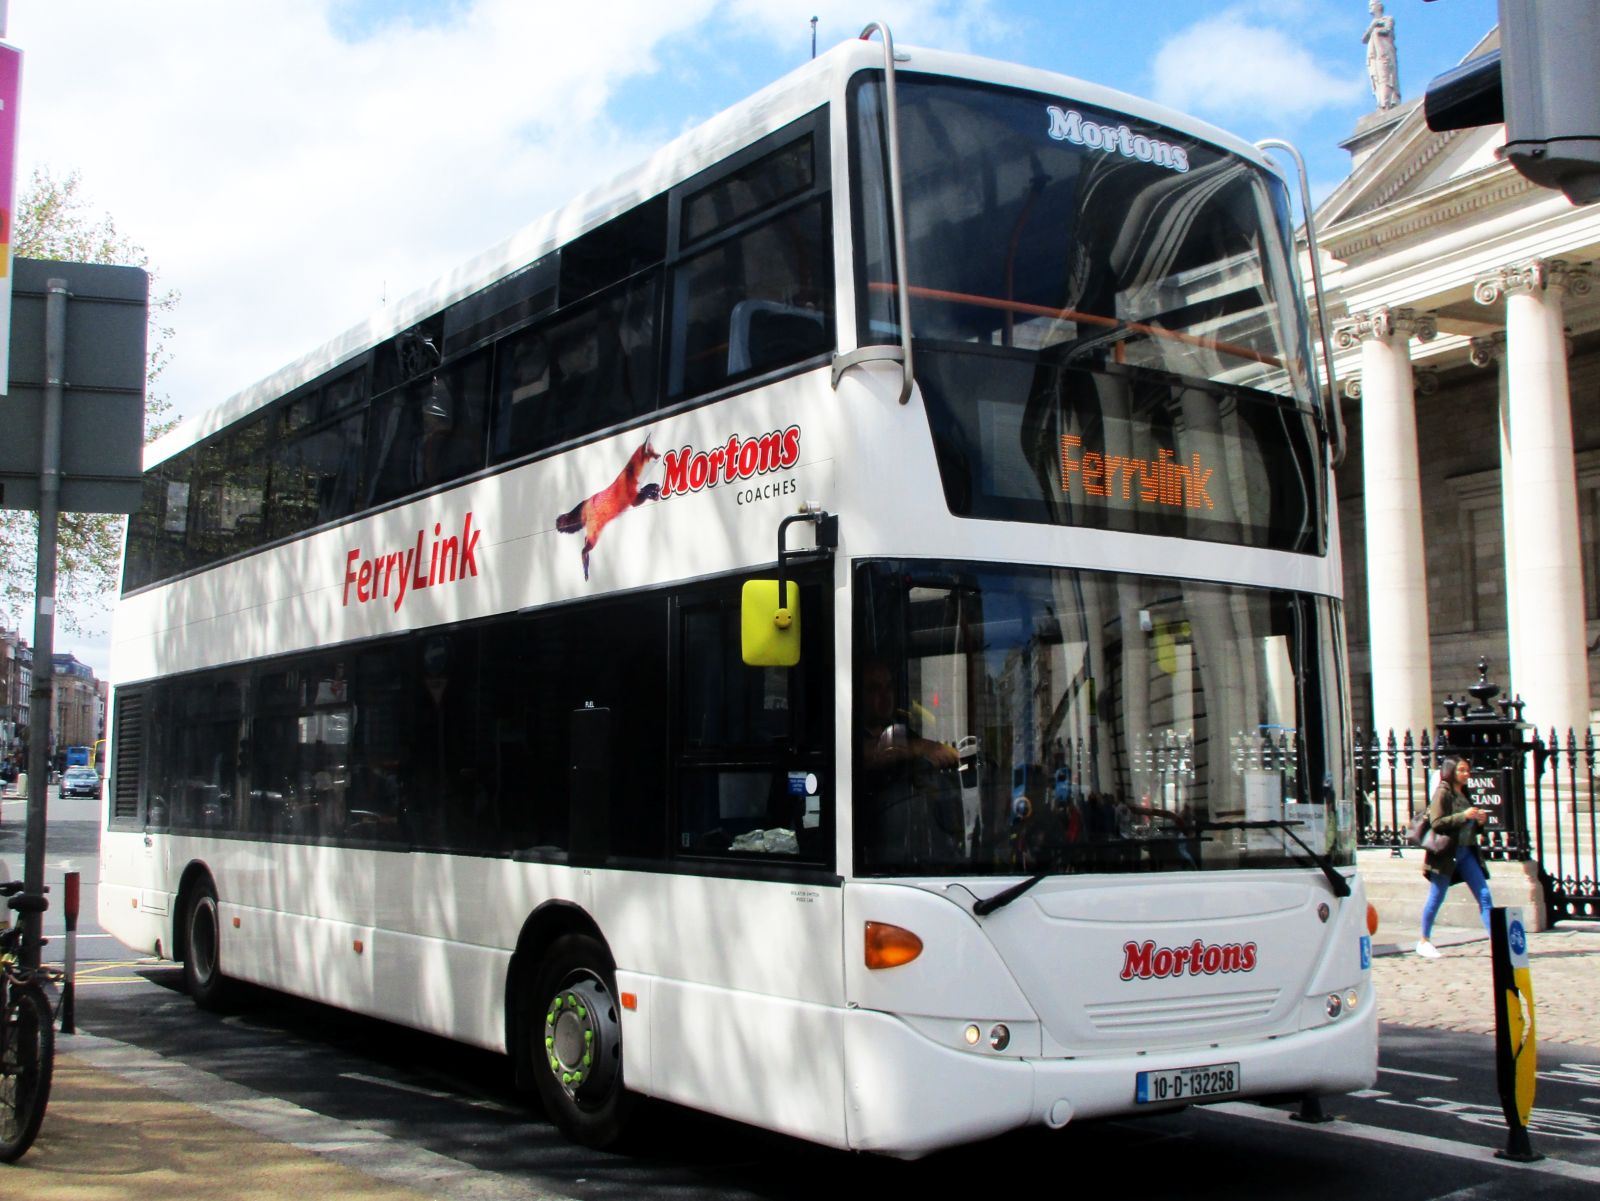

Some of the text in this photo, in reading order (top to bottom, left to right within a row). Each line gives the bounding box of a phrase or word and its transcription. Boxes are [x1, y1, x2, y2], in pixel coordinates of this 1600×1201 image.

[1047, 105, 1190, 173] Mortons
[659, 424, 802, 501] Mortons
[1060, 433, 1215, 510] Ferrylink
[736, 478, 798, 506] COACHES
[342, 511, 482, 613] FerryLink
[1467, 777, 1495, 788] BANK
[1120, 938, 1258, 982] Mortons
[1153, 1070, 1235, 1100] 10-D-132258
